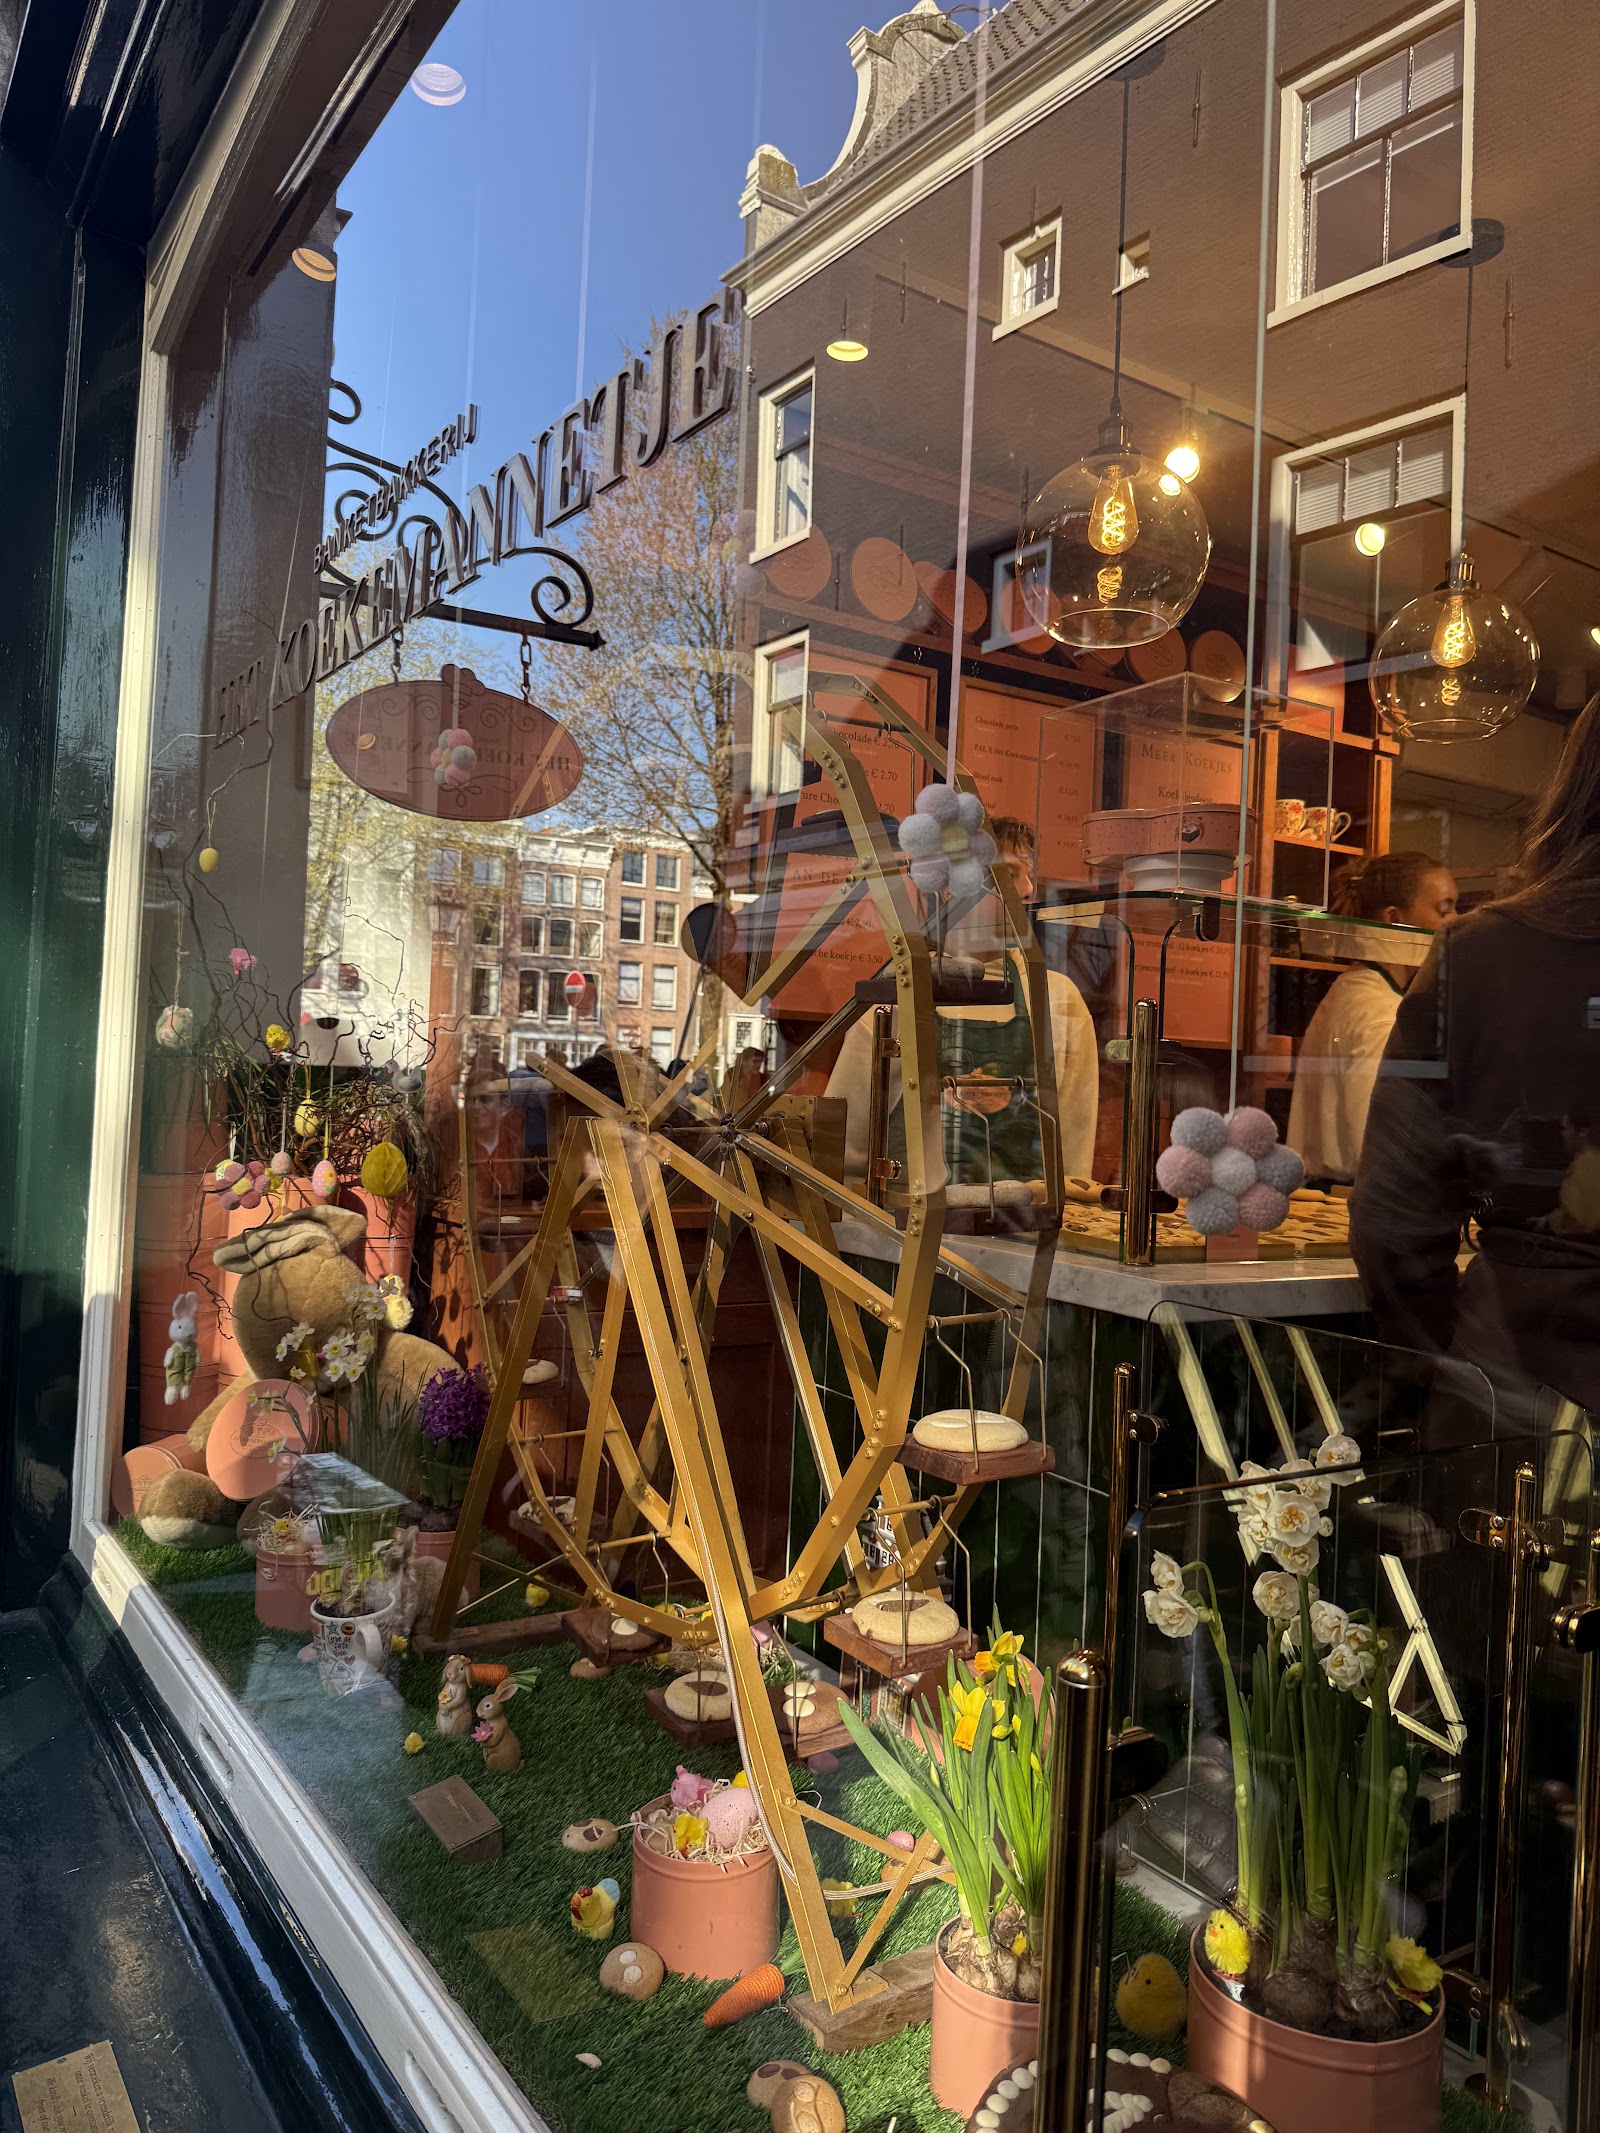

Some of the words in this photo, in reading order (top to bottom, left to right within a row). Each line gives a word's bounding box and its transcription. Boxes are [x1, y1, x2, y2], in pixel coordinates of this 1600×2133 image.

[214, 655, 266, 749] HET
[271, 286, 743, 711] KOEKEMANNETJE
[314, 403, 478, 575] BANKETBAKKERIJ
[869, 769, 878, 778] €
[880, 770, 898, 781] 2,70
[829, 949, 858, 962] koekje
[858, 953, 867, 962] €
[866, 953, 883, 964] 3,50
